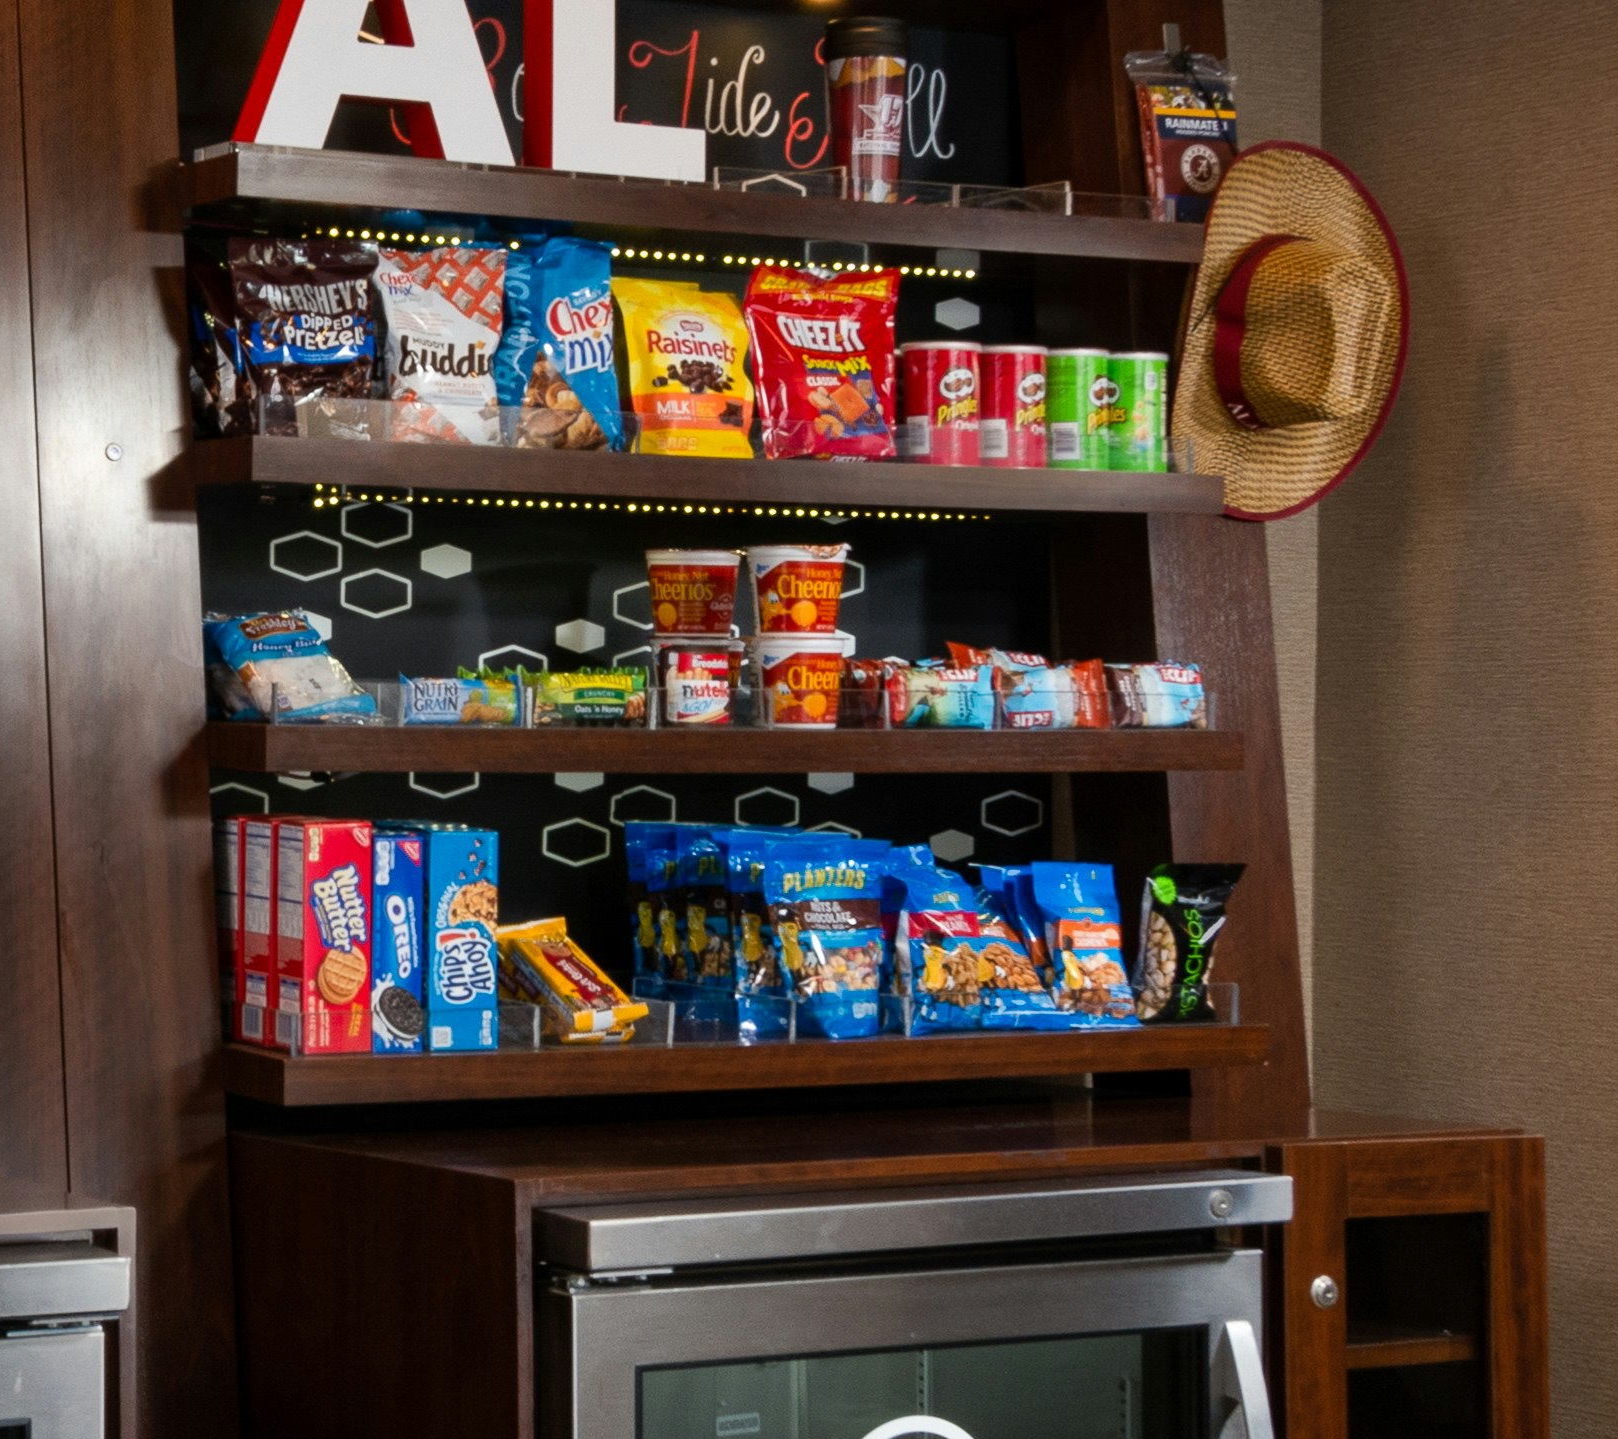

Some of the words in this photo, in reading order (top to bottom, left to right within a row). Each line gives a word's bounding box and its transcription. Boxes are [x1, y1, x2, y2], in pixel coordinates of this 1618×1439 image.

[1164, 117, 1219, 131] RAINMATE
[264, 278, 369, 314] HERSHEY'S
[545, 296, 613, 337] Chex
[413, 337, 446, 351] MUDDY
[645, 329, 738, 365] Raisinets
[834, 355, 872, 376] MIX
[655, 400, 691, 415] MILK
[252, 640, 292, 654] Honey
[412, 682, 460, 699] NUTRI
[412, 696, 460, 713] GRAIN
[574, 703, 593, 716] Oats
[602, 703, 626, 717] Honey
[782, 868, 867, 894] PLANTERS
[313, 877, 353, 955] Butter
[333, 863, 367, 944] Nutter
[435, 880, 461, 930] ORIGINAL
[803, 910, 854, 925] CHOCOLATE
[384, 894, 412, 980] OREO
[440, 940, 475, 1004] Chips
[1178, 907, 1205, 1018] ISTACHIOS
